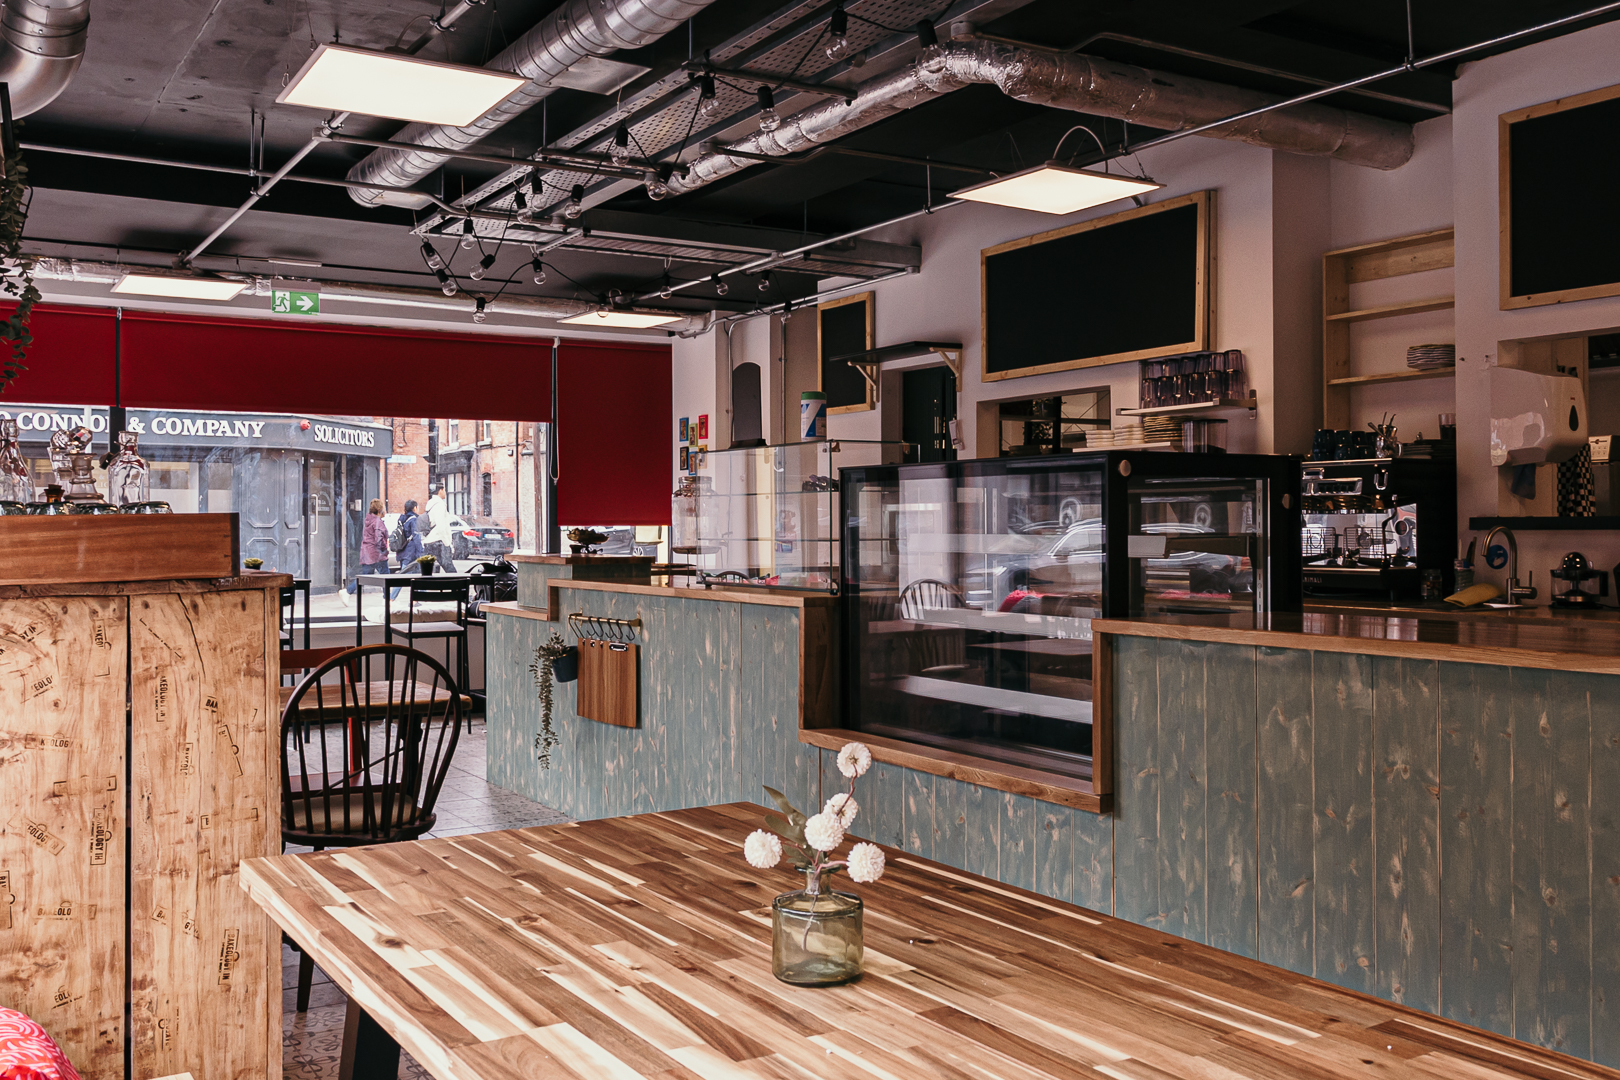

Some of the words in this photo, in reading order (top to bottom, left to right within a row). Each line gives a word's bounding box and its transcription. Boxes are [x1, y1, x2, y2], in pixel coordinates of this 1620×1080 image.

[16, 412, 109, 433] CONNO
[127, 417, 146, 434] &
[151, 417, 266, 438] COMPANY
[314, 424, 375, 448] SOLICITORS
